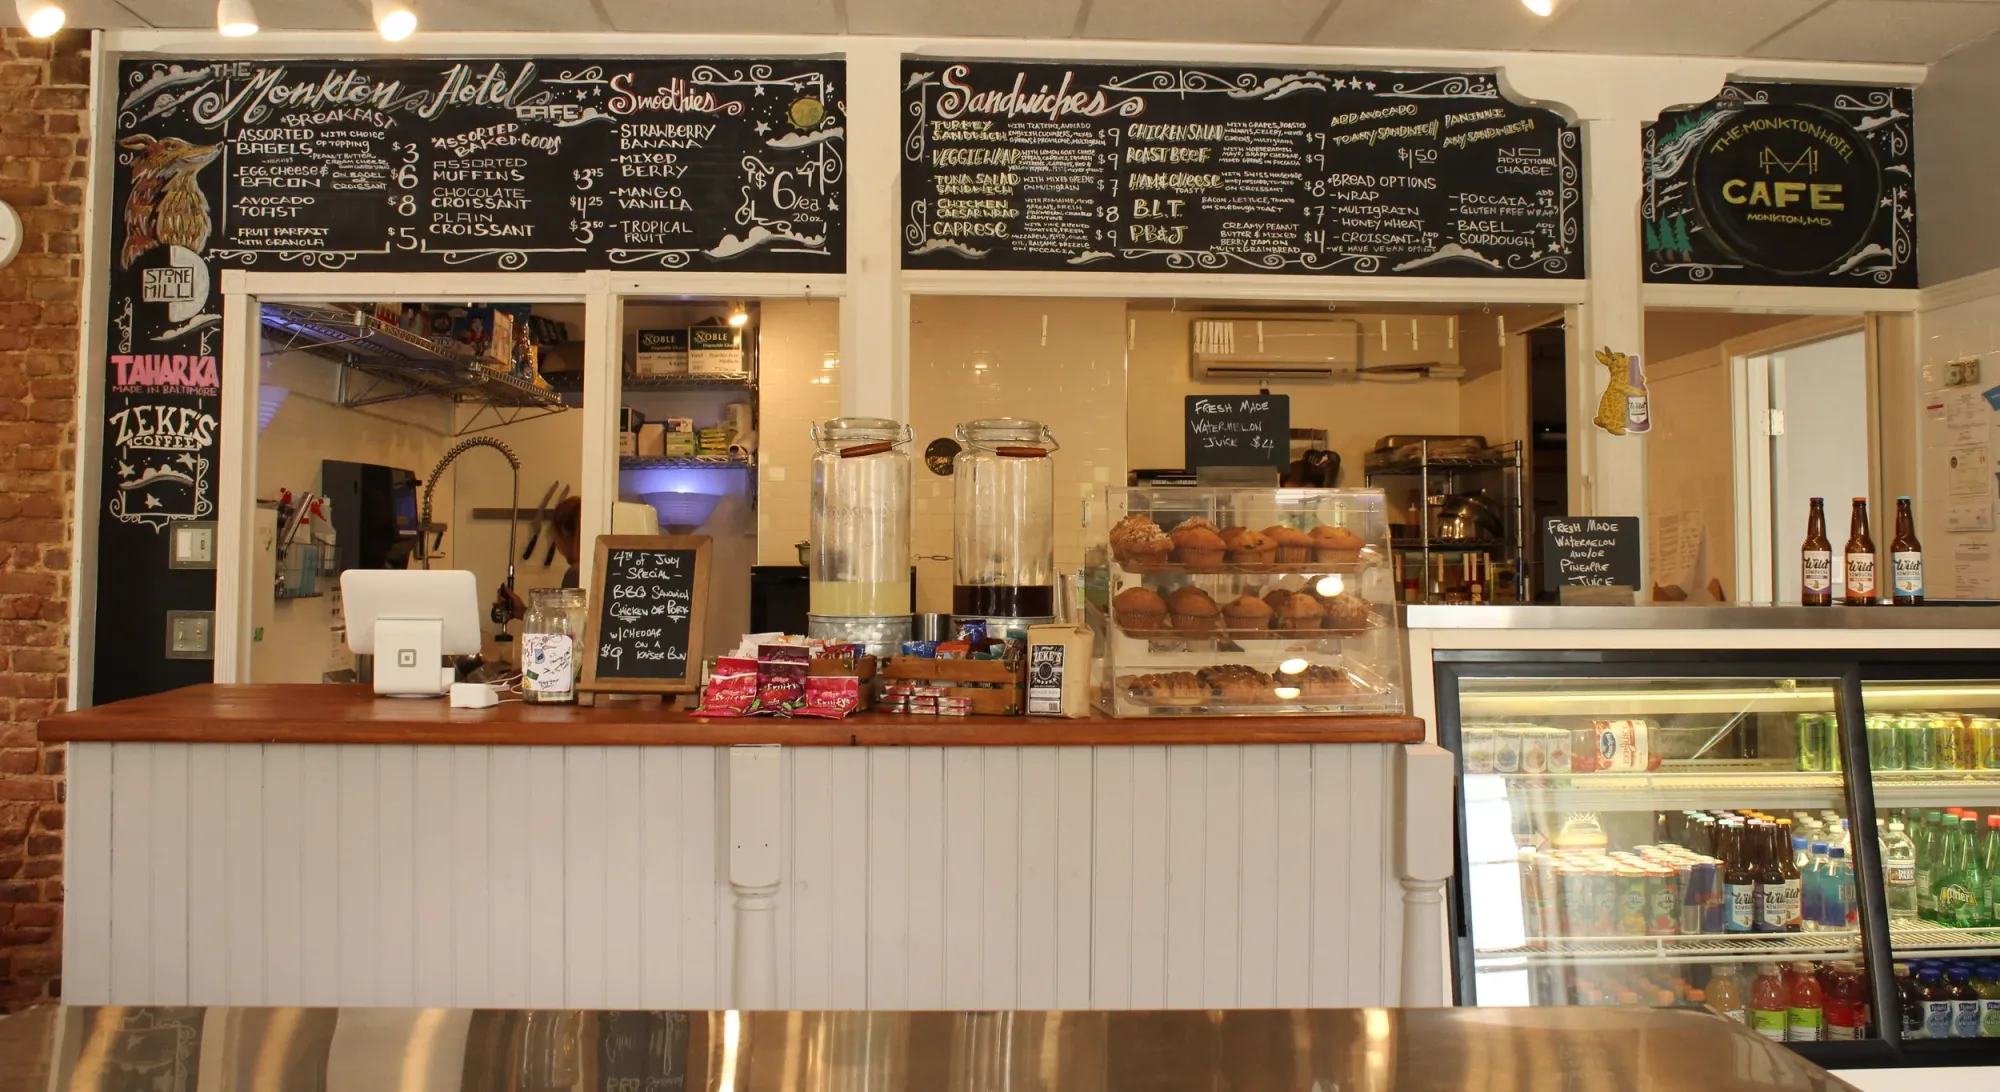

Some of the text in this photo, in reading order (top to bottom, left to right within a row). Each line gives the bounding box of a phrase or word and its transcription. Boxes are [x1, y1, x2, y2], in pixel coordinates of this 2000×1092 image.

[193, 61, 581, 124] THE Monkton Hotel CAFE
[608, 72, 728, 115] Smoothies
[937, 64, 1115, 121] Sandwiches
[1330, 104, 1418, 127] ADD AVOCADO
[931, 120, 995, 131] TURKEY
[1127, 123, 1187, 142] CHICKEN
[1186, 123, 1226, 142] SALAD
[237, 128, 347, 142] ASSORTED WITH
[931, 130, 1008, 142] SANDWICH
[1098, 127, 1120, 148] $9
[1305, 132, 1326, 151] $9
[1332, 135, 1353, 147] TO
[1351, 129, 1378, 147] ANY
[1442, 133, 1467, 150] ANY
[1743, 117, 1820, 138] MONKTON
[1819, 128, 1856, 164] HOTEL
[236, 142, 313, 155] BAGELS
[620, 138, 703, 150] BANANA
[392, 141, 420, 164] $3
[931, 147, 983, 168] VEGGIE
[982, 146, 1022, 167] WRAP
[1126, 147, 1166, 164] ROAST
[433, 158, 528, 169] ASSORTED
[1097, 152, 1119, 171] $9
[1304, 153, 1326, 172] $9
[1497, 157, 1559, 167] ADDITIONAL
[240, 166, 270, 177] EGG,
[390, 164, 419, 189] $6
[433, 169, 526, 182] MUFFINS
[622, 165, 688, 179] BERRY
[1495, 165, 1554, 176] CHARGE
[239, 177, 321, 188] BACON
[934, 172, 1021, 186] TUNA SALAD
[1379, 176, 1437, 190] OPTIONS
[433, 187, 526, 199] CHOCOLATE
[618, 186, 682, 198] MANGO
[936, 184, 1014, 196] SANDWICH
[1096, 178, 1119, 198] $7
[1174, 187, 1206, 195] TOASTY
[1303, 180, 1326, 198] $8
[239, 196, 315, 205] AVOCADO
[1337, 191, 1380, 202] WRAP
[1459, 192, 1527, 206] FOCCAIA
[1721, 179, 1845, 212] CAFE
[387, 194, 417, 217] $8
[431, 197, 532, 211] CROISSANT
[619, 198, 693, 212] VANILLA
[936, 198, 1009, 210] CHICKEN
[1460, 205, 1497, 215] GLUTEN
[1499, 206, 1525, 217] FREE
[239, 206, 303, 218] TOAST
[433, 212, 494, 224] PLAIN
[983, 208, 1021, 219] WRAP
[1096, 205, 1120, 223] $8
[1303, 205, 1325, 225] $7
[429, 223, 536, 237] CROISSANT
[620, 220, 693, 234] TROPICAL
[1222, 222, 1300, 232] CREAMY PEANUT
[1341, 218, 1382, 231] HONEY
[1457, 219, 1515, 233] BAGEL
[238, 227, 330, 237] FRUIT PARFAIT
[387, 226, 418, 250] $5
[624, 233, 666, 244] FRUIT
[1094, 229, 1118, 248] $9
[1129, 224, 1188, 244] PB&J
[1341, 231, 1414, 245] CROISSANT
[237, 238, 325, 247] WITH GRANOLA
[1220, 238, 1249, 248] BERRY
[1303, 229, 1326, 254] $4
[1459, 232, 1536, 249] SOURDOUGH
[1272, 246, 1301, 254] BREAD
[1347, 245, 1405, 253] HAVE VEGAN
[144, 267, 193, 284] STONE
[642, 332, 676, 347] NOBLE
[694, 329, 728, 344] NOBLE
[110, 354, 220, 388] TAHARKA
[112, 385, 218, 397] MADE IN BALTIMORE
[1194, 398, 1270, 415] FRESH MADE
[109, 404, 219, 447] ZEKE'S
[1190, 418, 1263, 435] WATERMELON
[132, 434, 197, 449] COFFEE
[1203, 435, 1275, 460] JUICE $4
[1547, 518, 1619, 534] FRESH MADE
[1554, 535, 1616, 548] WATERMELON
[1569, 547, 1606, 560] AND/OR
[1559, 558, 1610, 573] PINEAPPLE
[1567, 574, 1615, 586] JUICE
[612, 584, 647, 600] BBQ
[609, 599, 689, 617] CHICKEN OR PORK
[634, 640, 661, 649] ON A
[600, 643, 624, 671] $9
[636, 646, 687, 661] KAISER BUN
[1033, 651, 1063, 663] ZEKE'S
